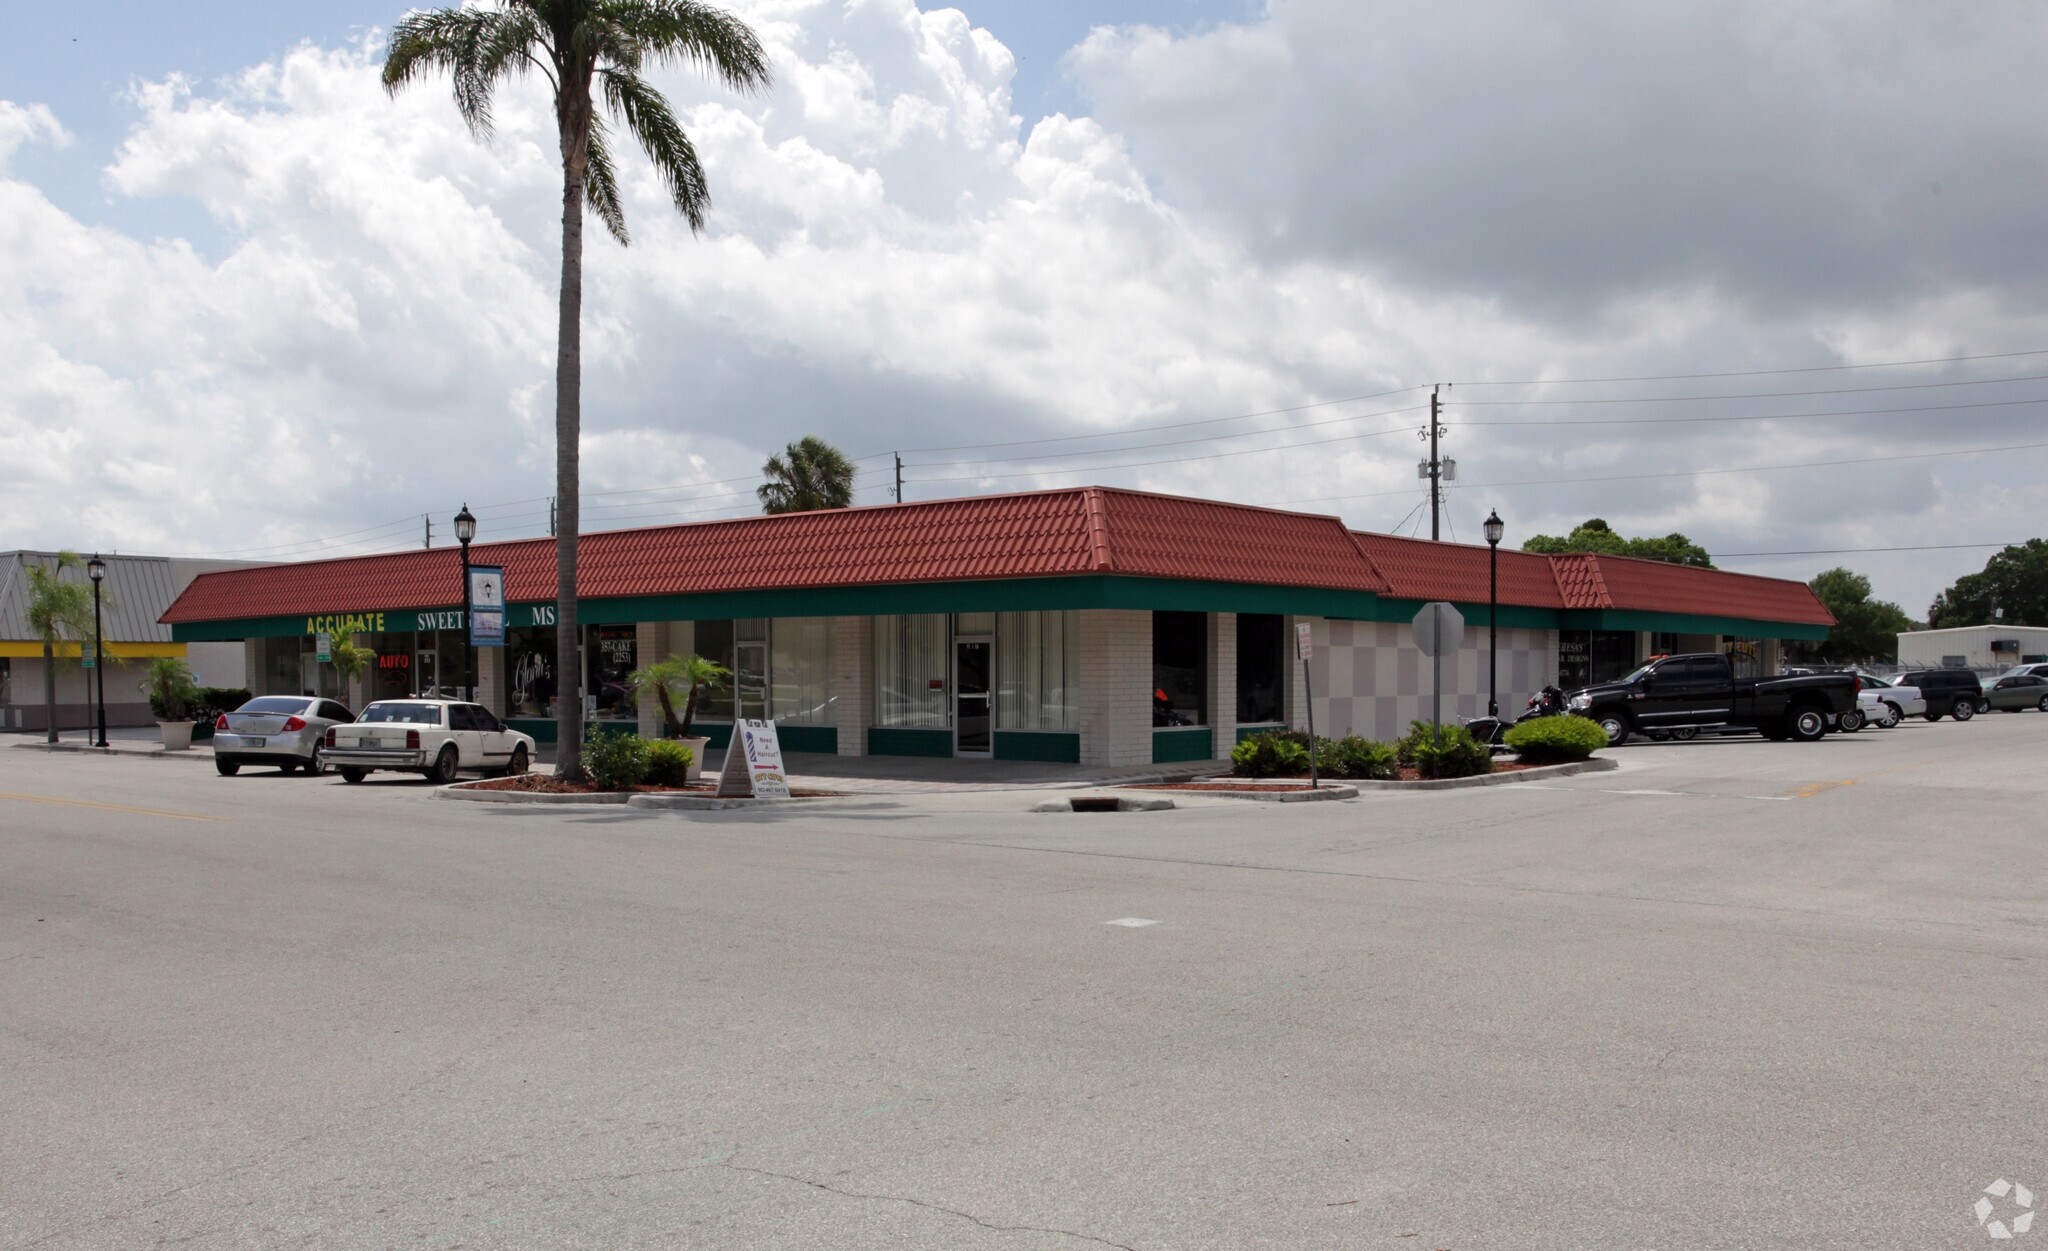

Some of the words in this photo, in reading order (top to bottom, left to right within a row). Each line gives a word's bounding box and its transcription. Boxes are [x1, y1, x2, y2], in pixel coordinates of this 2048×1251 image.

[307, 613, 385, 634] ACCURATE
[418, 611, 464, 631] SWEET
[532, 606, 555, 625] MS
[380, 656, 409, 668] AUTO
